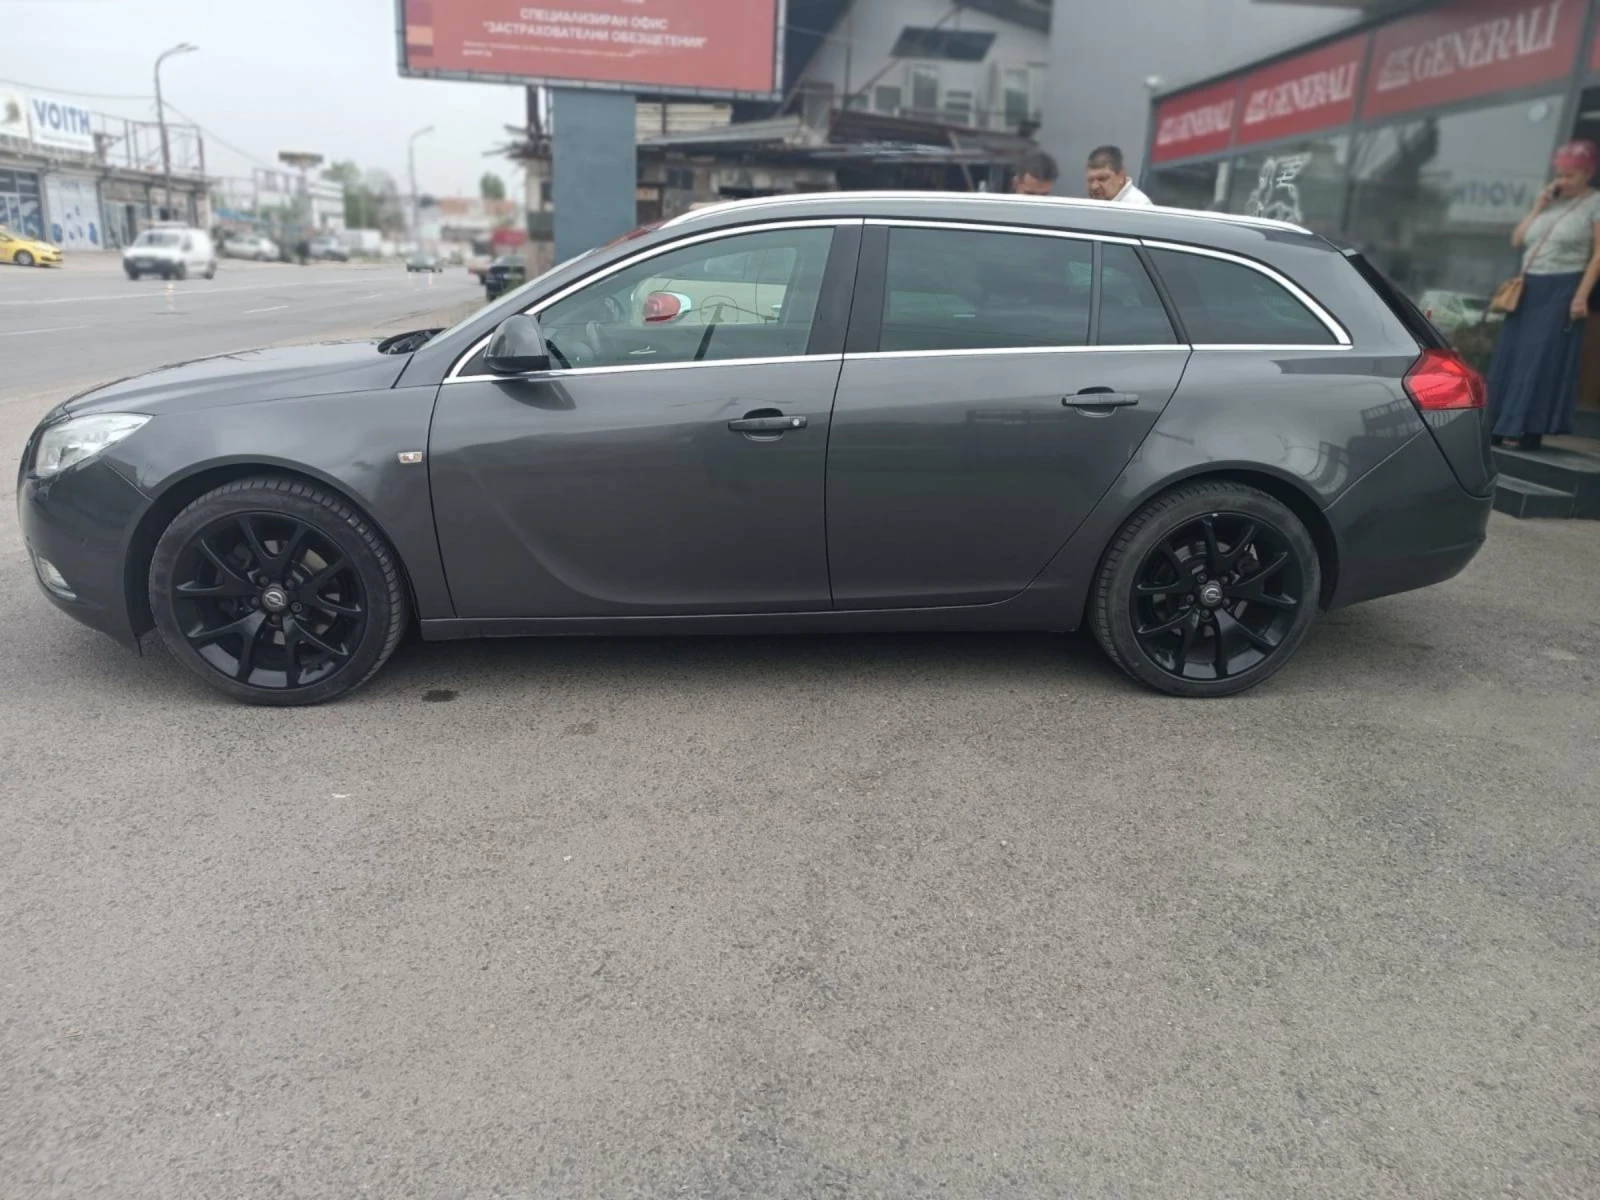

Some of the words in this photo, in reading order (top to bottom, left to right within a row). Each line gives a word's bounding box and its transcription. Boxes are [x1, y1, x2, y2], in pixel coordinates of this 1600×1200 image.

[519, 8, 629, 26] СПЕЦИАЛИЗИРАН
[632, 15, 669, 30] ОФИС
[1414, 0, 1561, 82] GENERALI
[1267, 63, 1357, 116] GENERALI
[32, 99, 90, 135] VOITH
[1173, 99, 1235, 140] GENERALI
